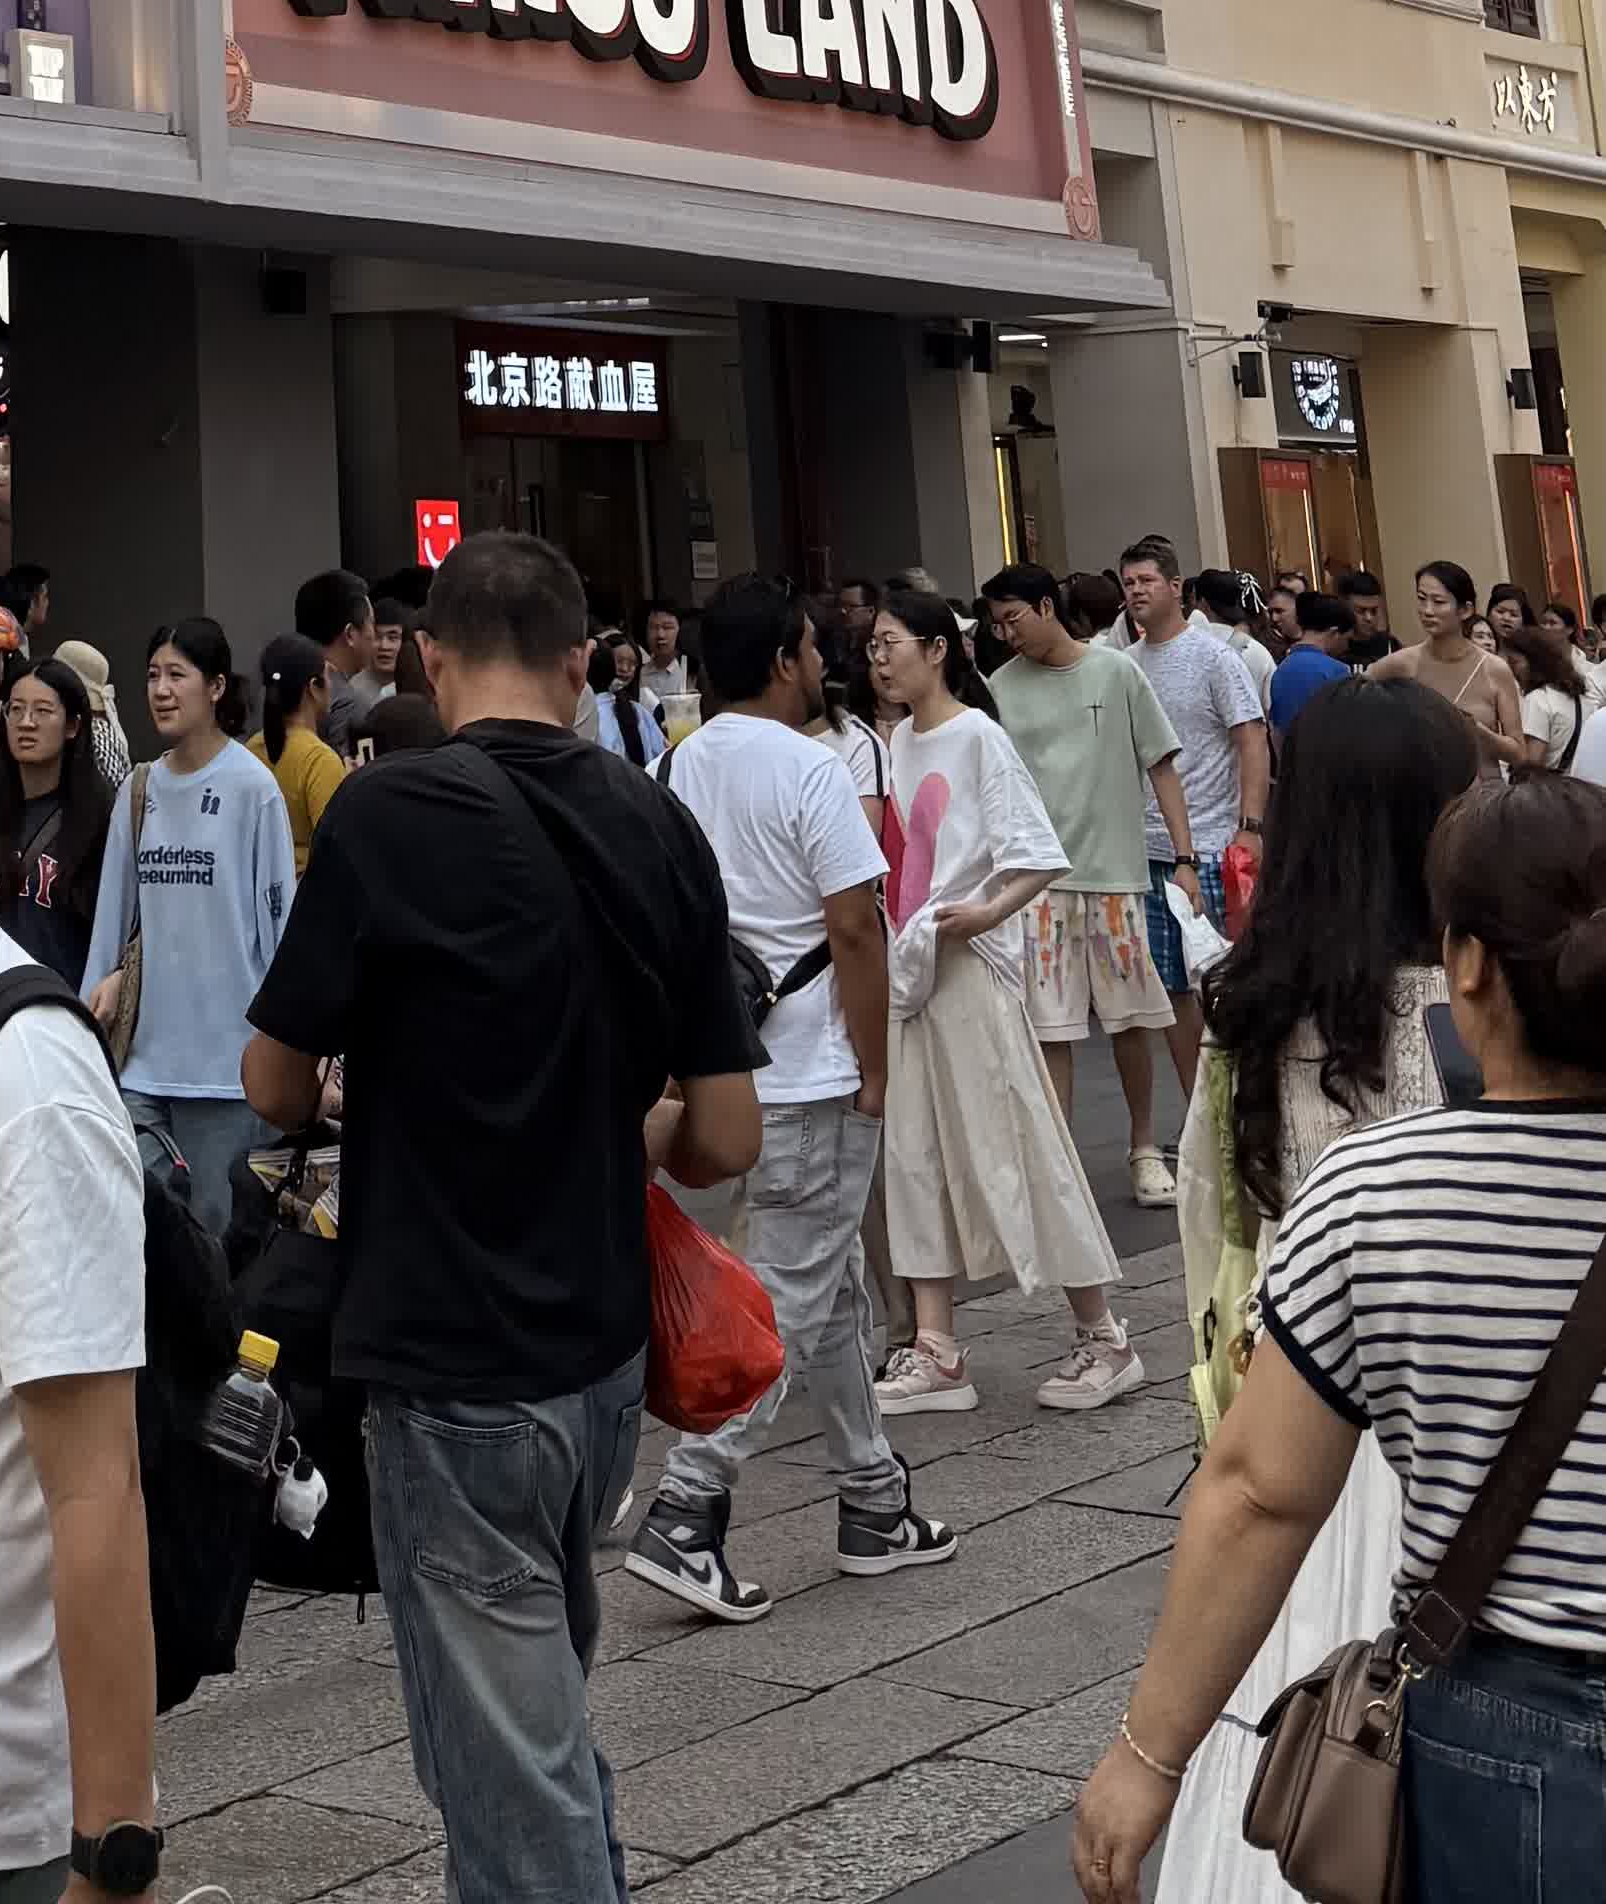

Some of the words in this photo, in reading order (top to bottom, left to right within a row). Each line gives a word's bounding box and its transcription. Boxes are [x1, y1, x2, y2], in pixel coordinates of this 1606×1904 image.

[464, 348, 659, 414] 北京路献血屋
[138, 848, 216, 868] orderless
[138, 866, 214, 887] eeumind
